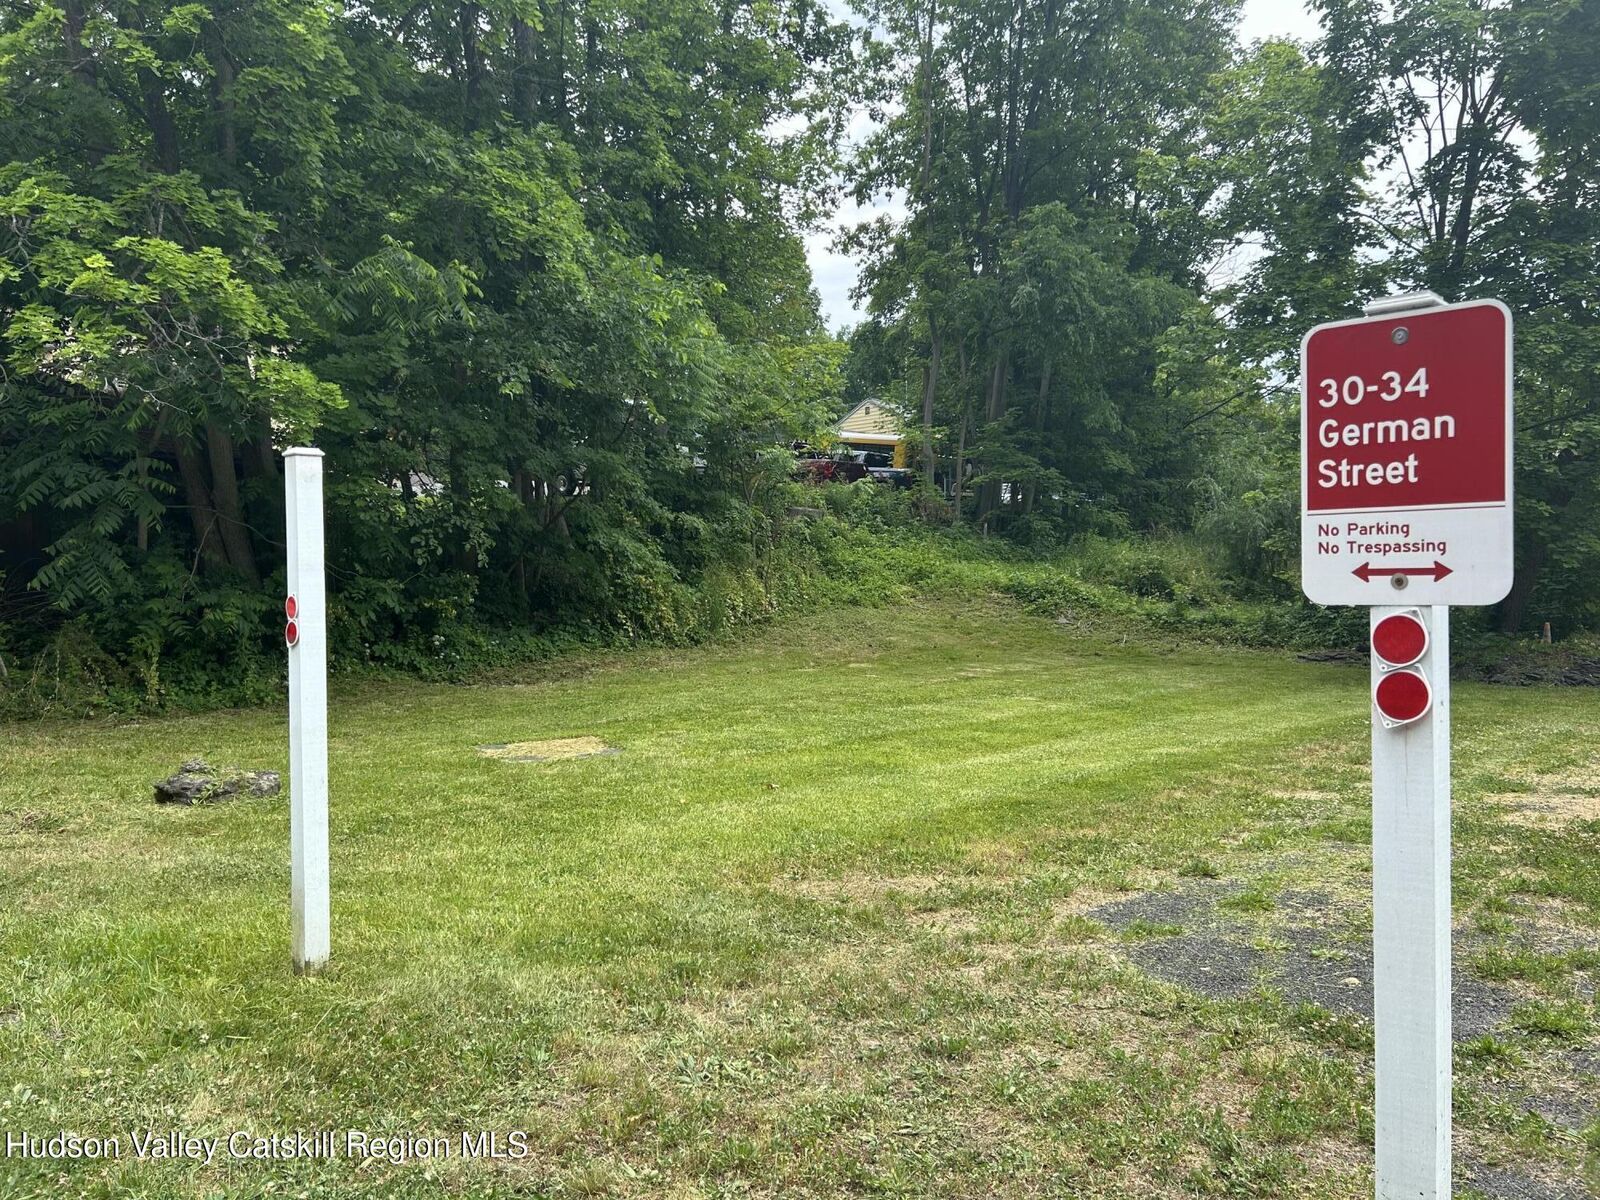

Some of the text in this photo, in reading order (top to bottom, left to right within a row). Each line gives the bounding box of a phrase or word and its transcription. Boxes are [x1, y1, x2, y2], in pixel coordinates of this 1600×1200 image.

[1318, 367, 1429, 408] 30-34
[1318, 414, 1456, 449] German
[1317, 453, 1419, 489] Street
[1318, 521, 1410, 539] No Parking
[1318, 539, 1447, 557] No Trespassing
